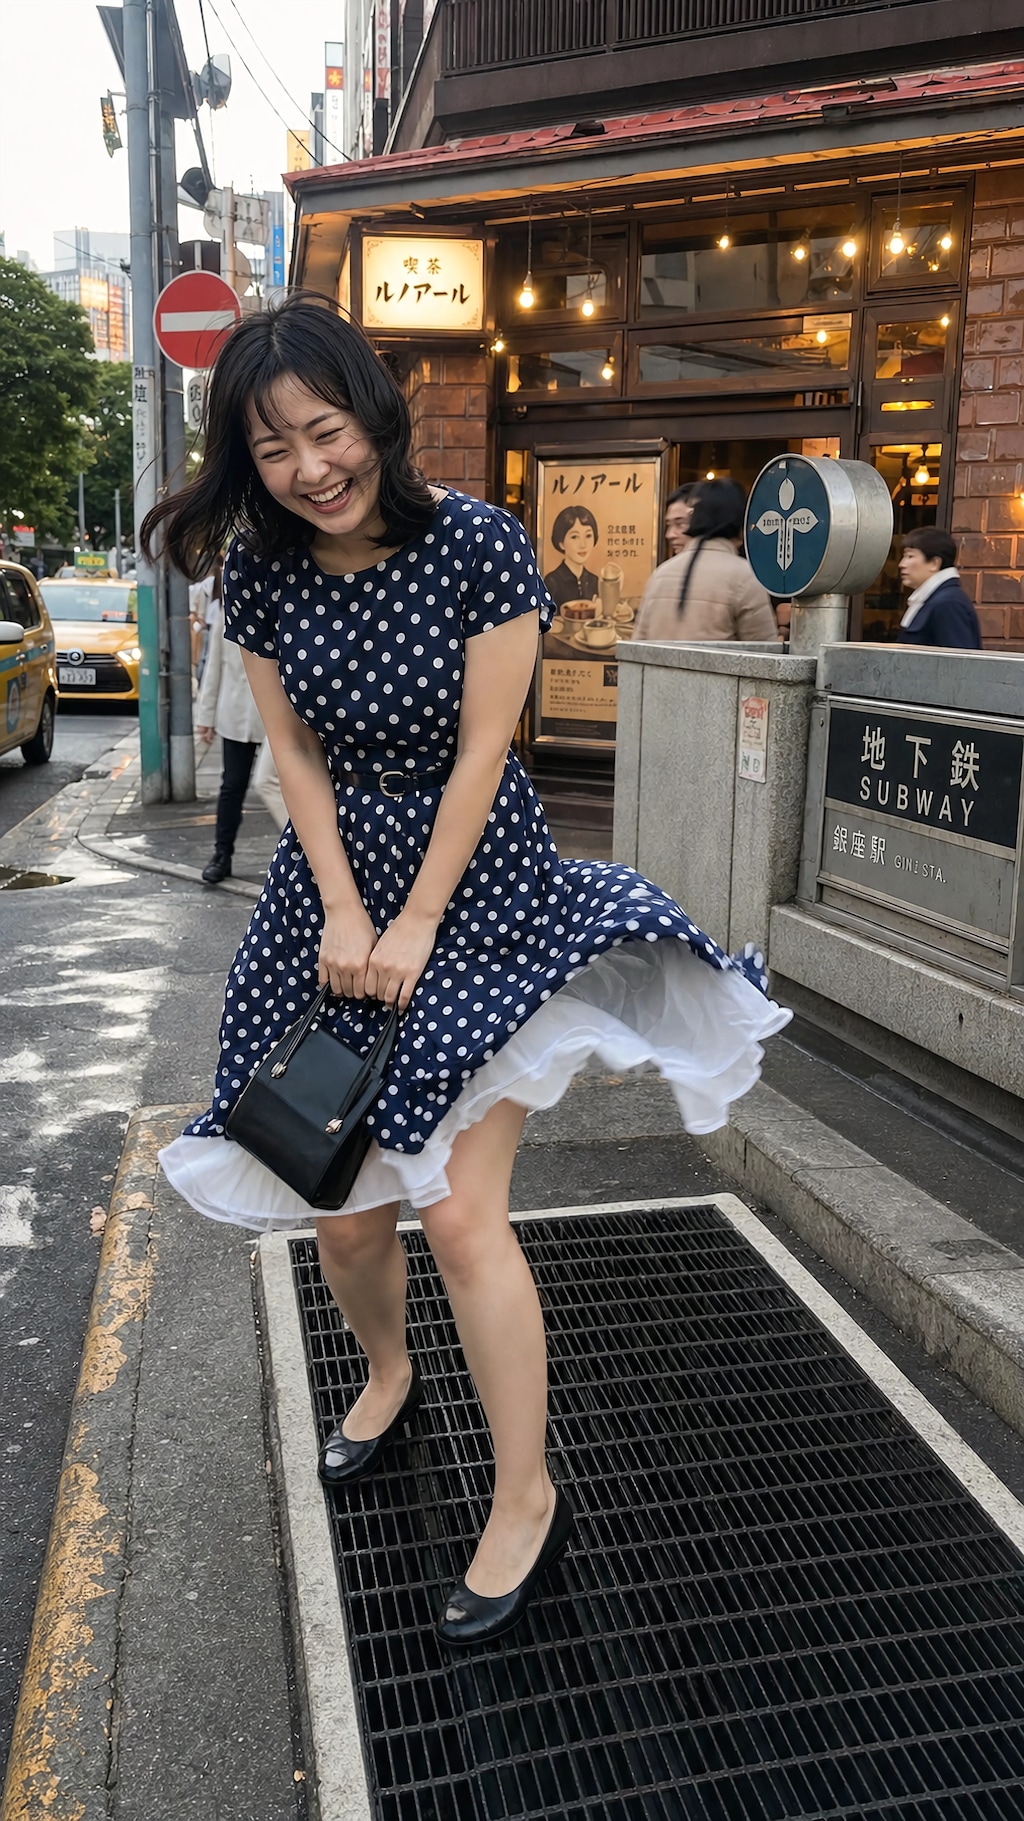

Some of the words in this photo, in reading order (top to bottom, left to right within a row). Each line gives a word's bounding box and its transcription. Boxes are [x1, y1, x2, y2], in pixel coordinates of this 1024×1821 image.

[403, 256, 442, 275] 喫茶
[375, 281, 471, 305] ルノアール
[552, 472, 643, 495] ルノアール
[860, 725, 981, 792] 地下鉄
[859, 775, 975, 827] SUBWAY
[832, 824, 887, 866] 銀座駅
[921, 863, 948, 883] STA.
